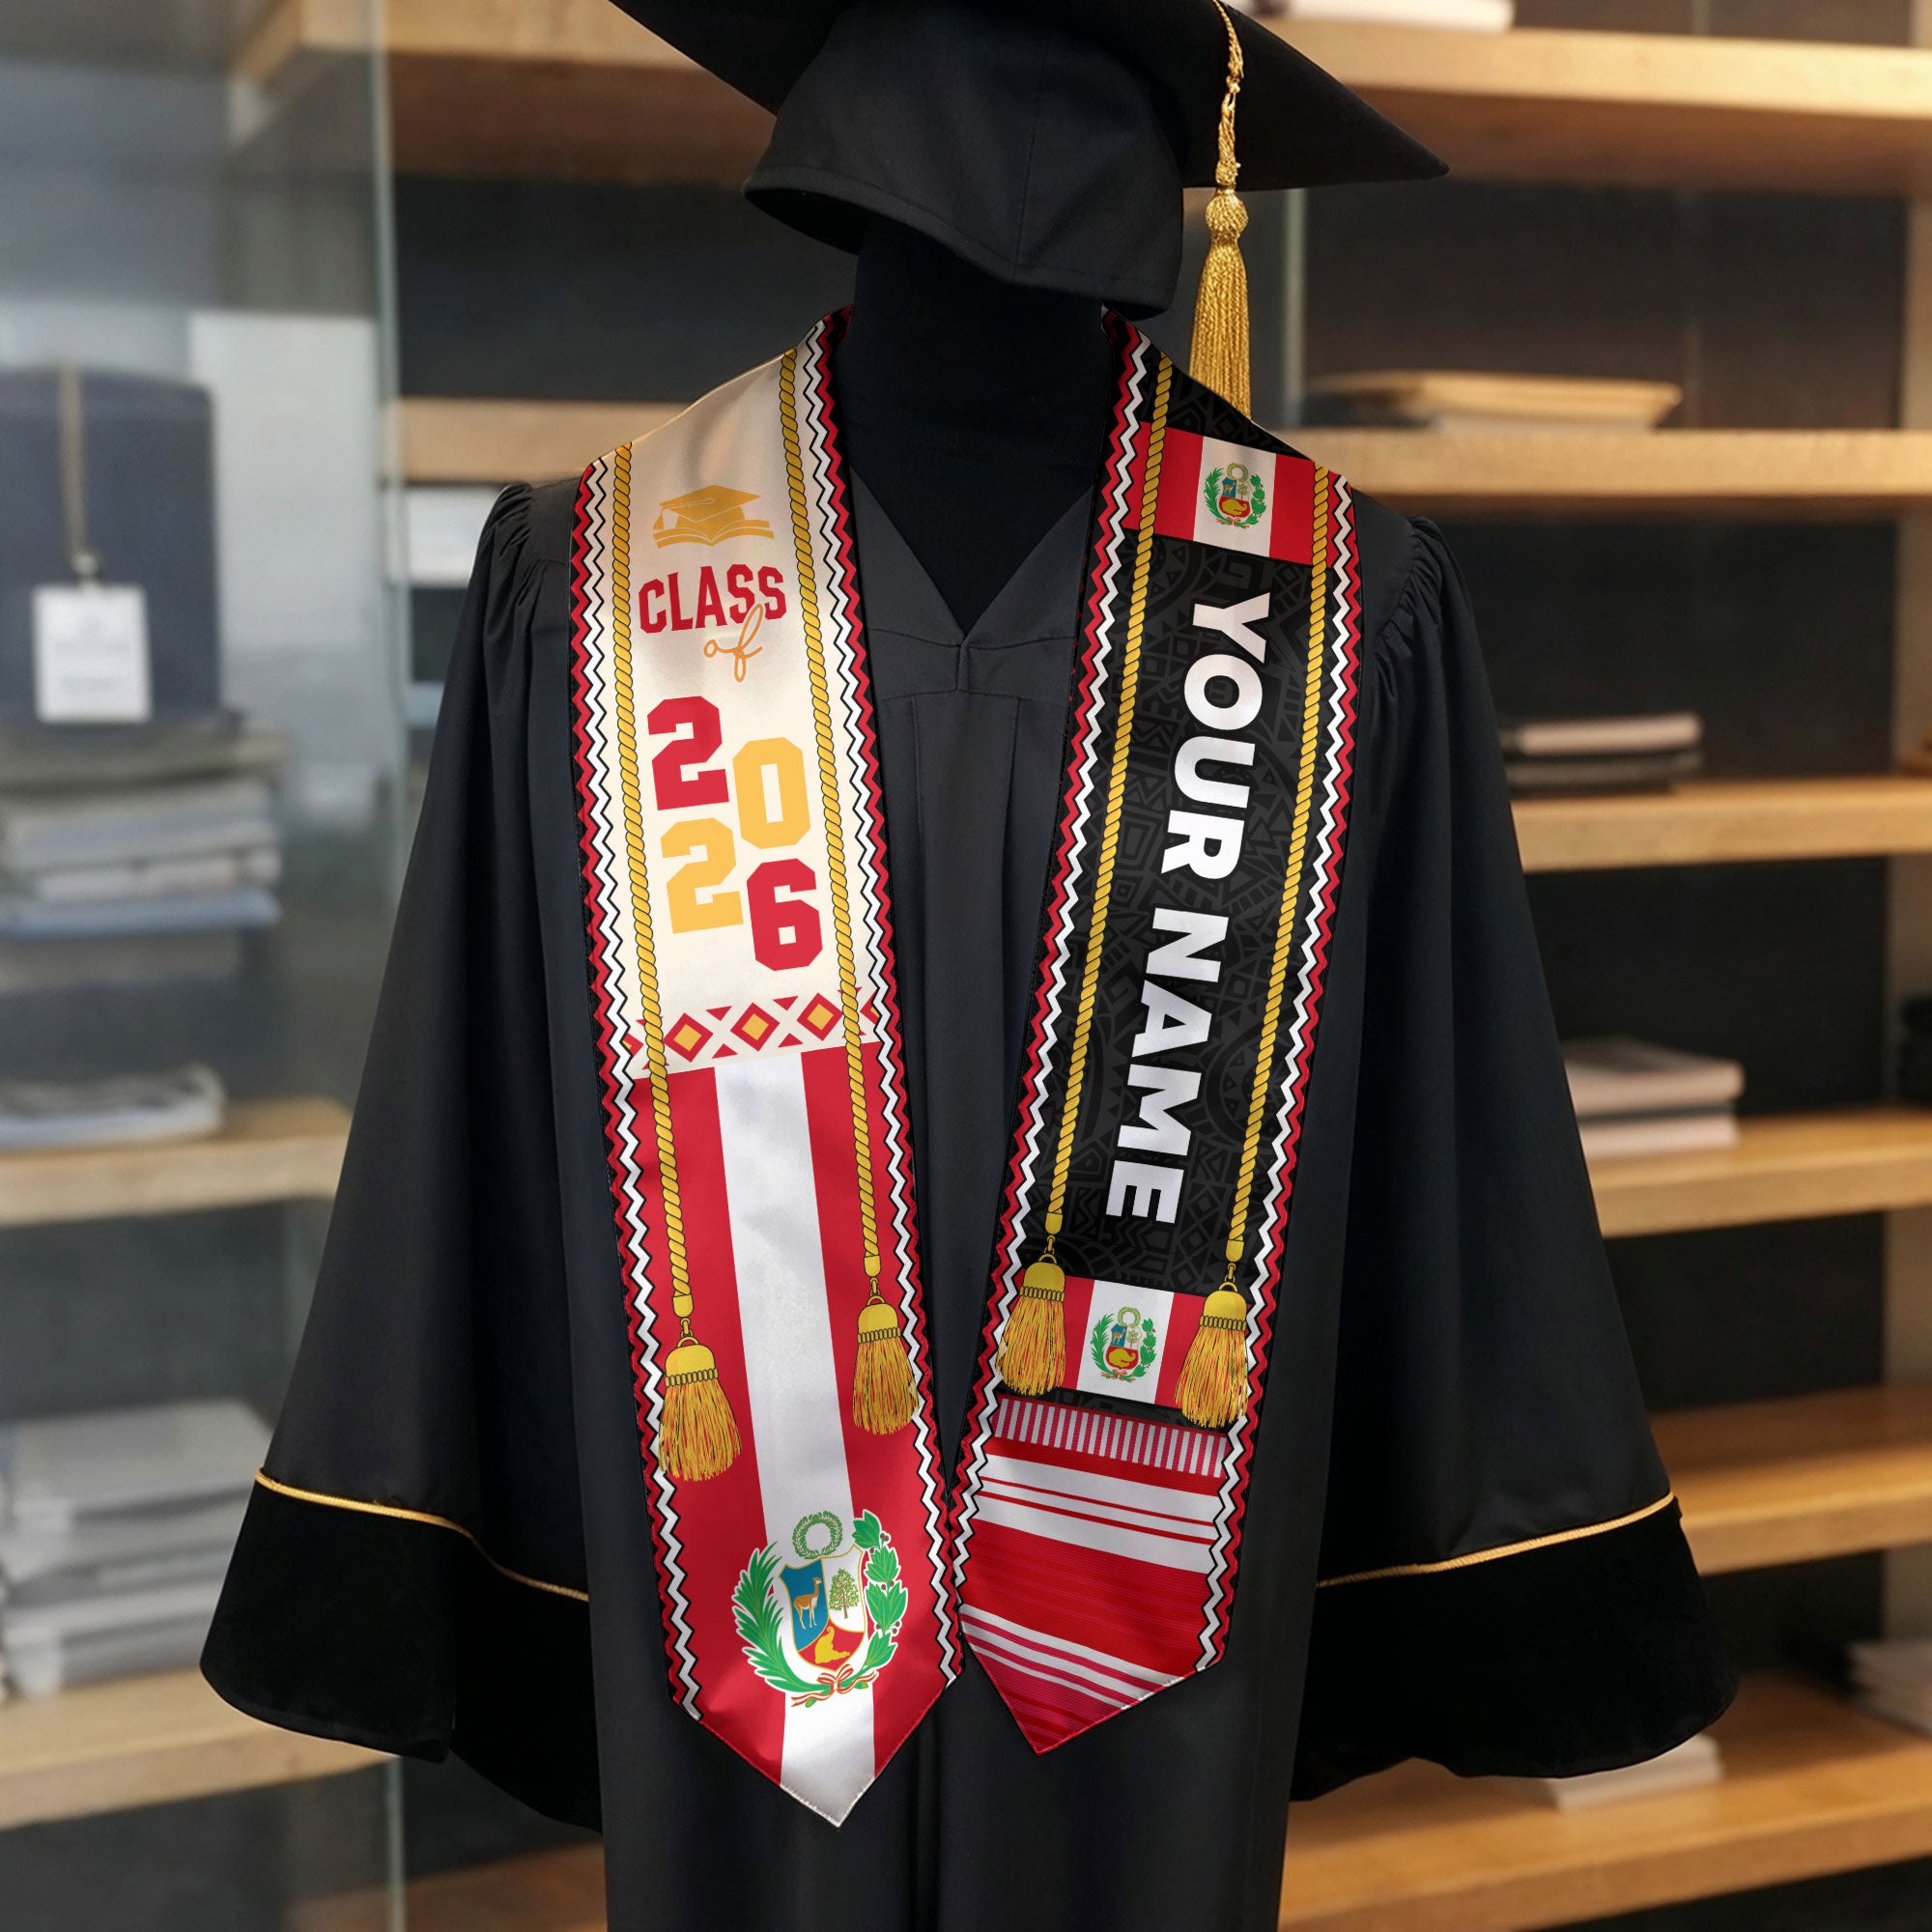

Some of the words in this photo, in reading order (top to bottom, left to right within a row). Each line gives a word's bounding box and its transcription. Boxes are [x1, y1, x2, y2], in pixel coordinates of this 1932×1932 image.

[639, 563, 787, 634] CLASS
[703, 604, 764, 683] of
[1161, 591, 1271, 881] YOUR
[1105, 907, 1230, 1225] NAME
